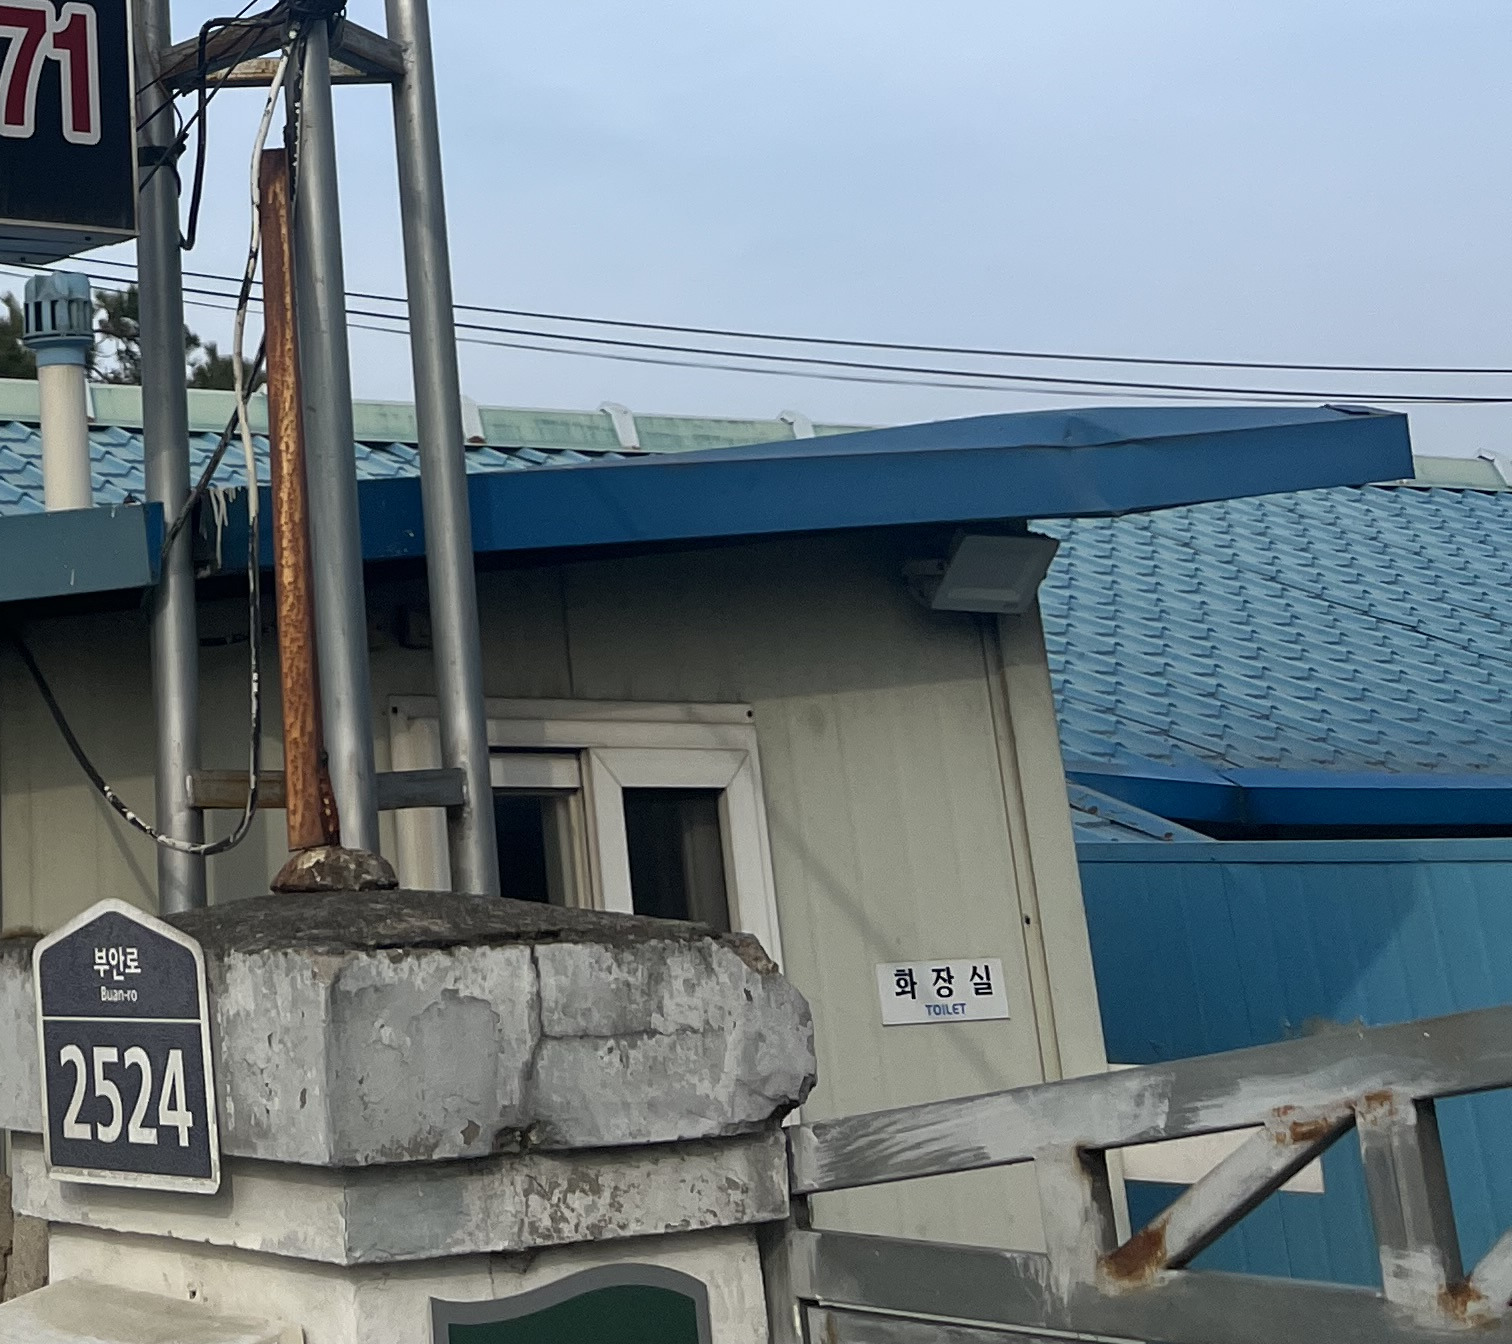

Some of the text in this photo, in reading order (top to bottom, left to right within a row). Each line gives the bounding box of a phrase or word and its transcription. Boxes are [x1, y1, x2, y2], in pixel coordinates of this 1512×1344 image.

[93, 947, 142, 980] 부안로
[100, 985, 138, 1002] Buan-ro
[894, 964, 994, 1000] 화장실
[925, 1002, 967, 1016] TOILET
[60, 1044, 193, 1147] 2524
